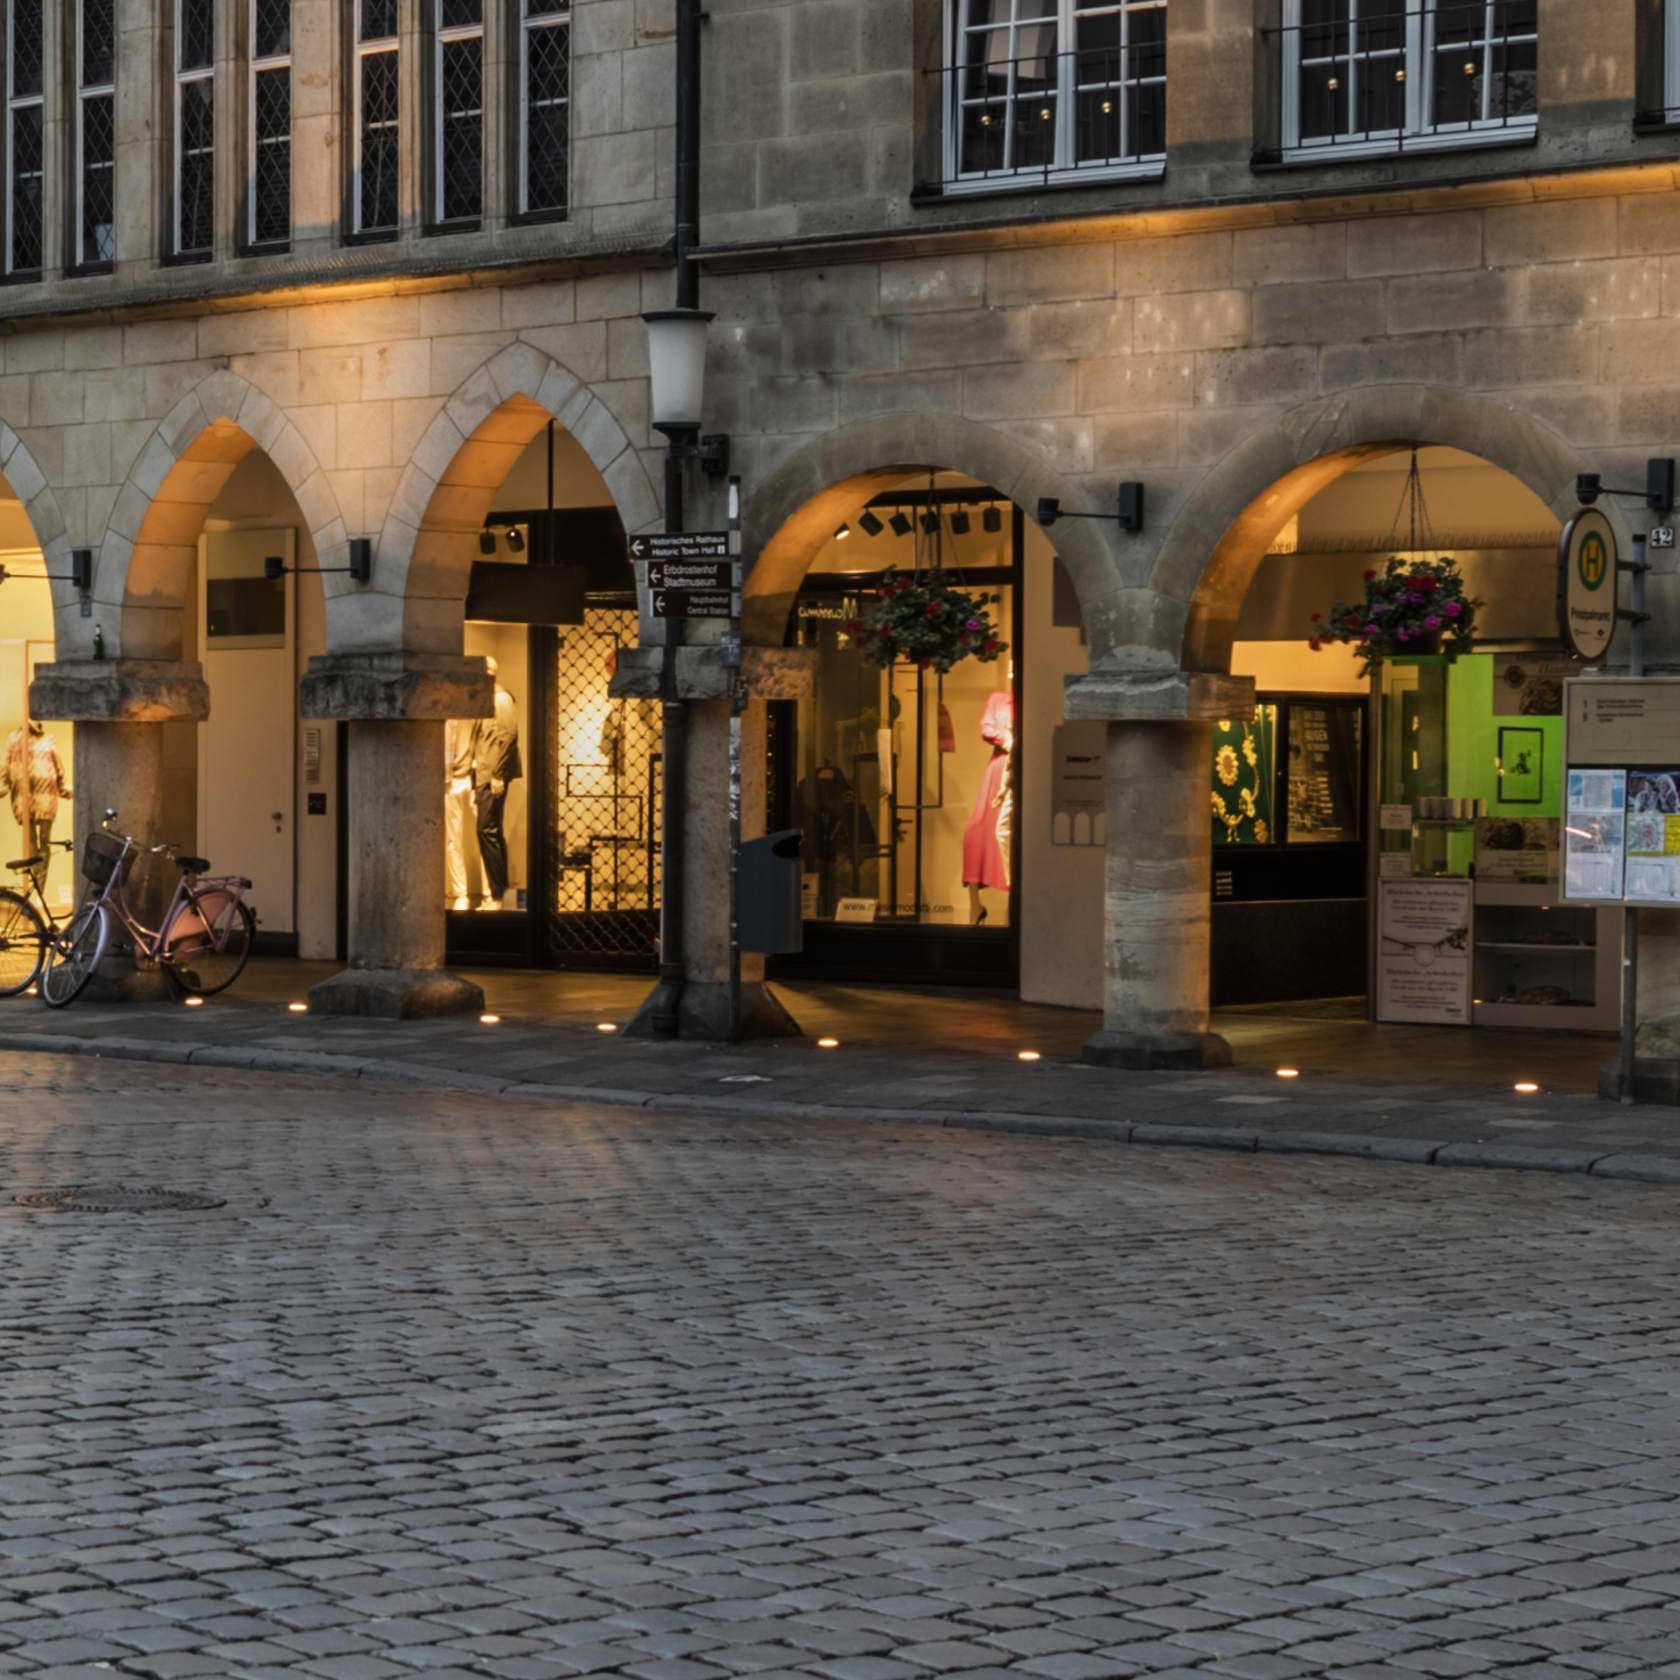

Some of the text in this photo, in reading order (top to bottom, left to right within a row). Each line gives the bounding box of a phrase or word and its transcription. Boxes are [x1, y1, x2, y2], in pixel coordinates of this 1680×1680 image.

[650, 535, 725, 545] Historisches Rathaus
[1653, 530, 1672, 545] 42
[652, 548, 679, 556] Historic
[681, 547, 699, 555] Town
[663, 564, 718, 575] Erbdrostenhof
[663, 577, 716, 587] Stadtmuseum
[690, 596, 729, 604] Hauptbahnhof
[687, 606, 707, 614] Central
